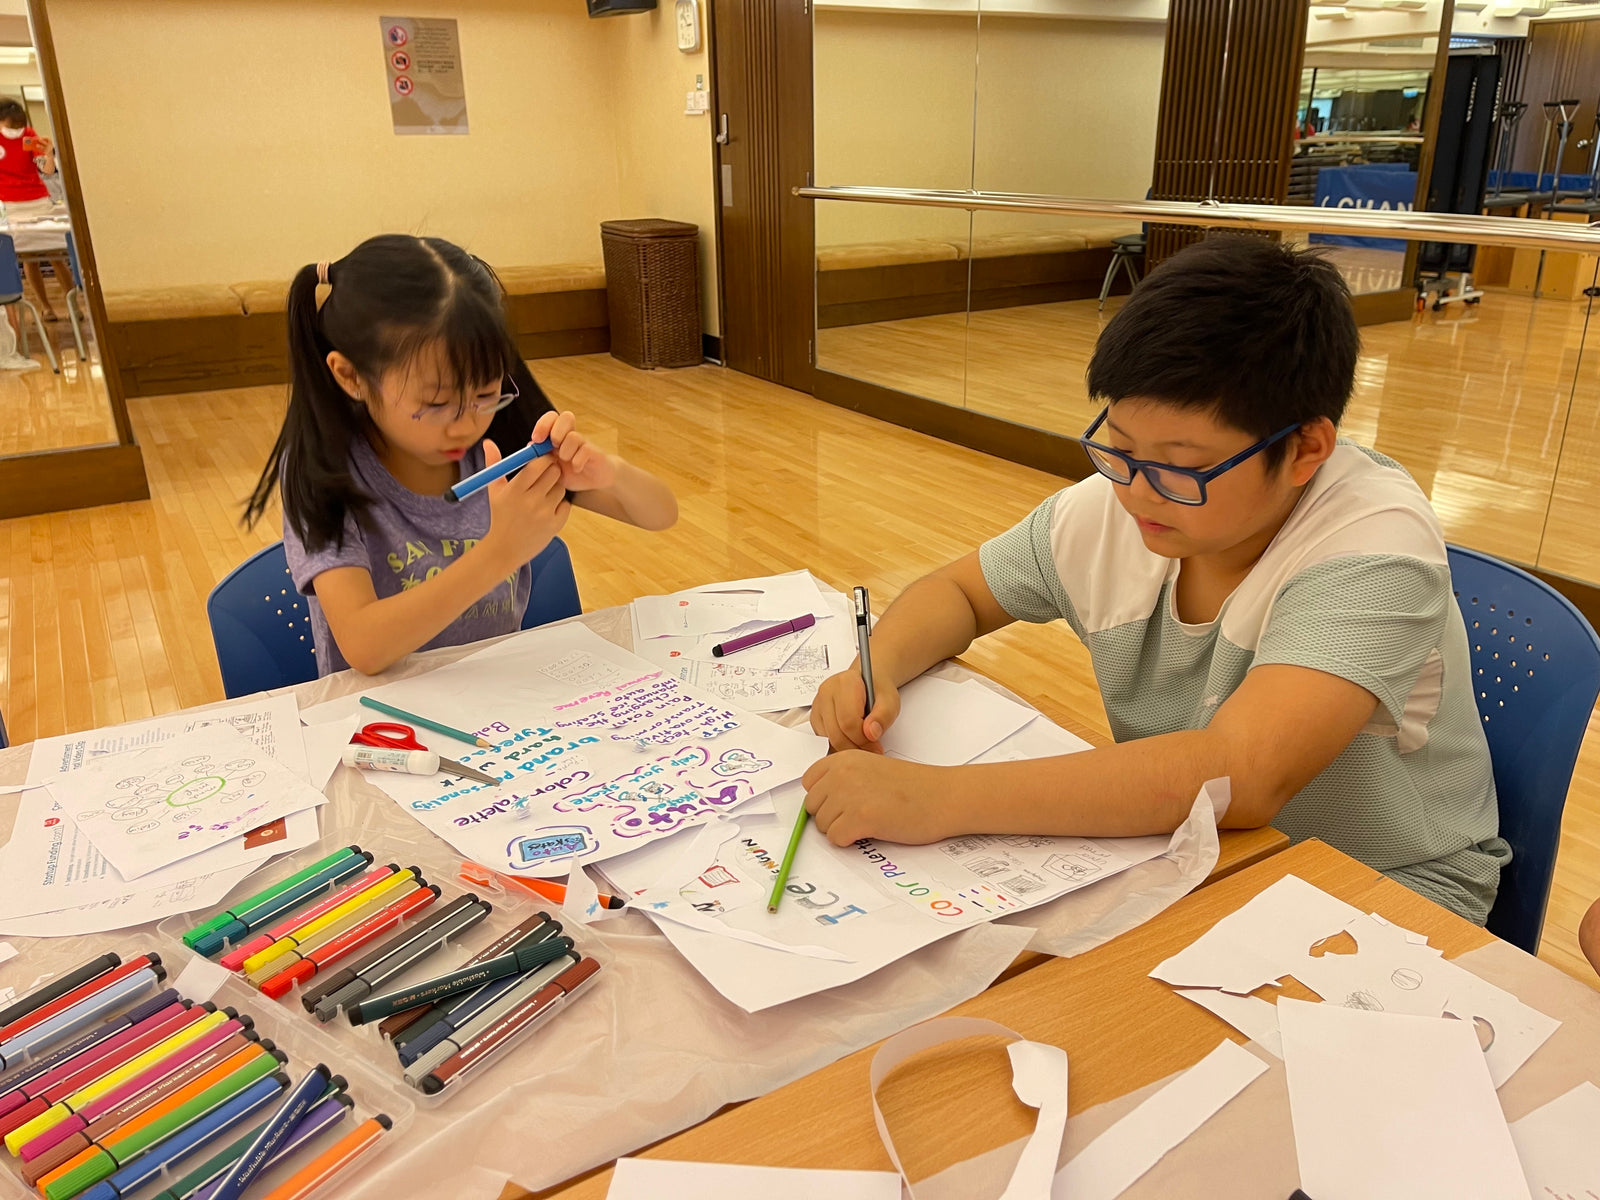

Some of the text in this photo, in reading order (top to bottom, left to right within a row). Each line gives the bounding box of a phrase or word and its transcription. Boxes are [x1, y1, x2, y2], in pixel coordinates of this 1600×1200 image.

[652, 677, 677, 689] into
[609, 701, 629, 713] ice
[656, 695, 693, 711] Pain
[587, 717, 609, 728] the
[456, 726, 554, 765] Typefac
[517, 735, 601, 773] brand
[440, 734, 562, 788] hard wrk
[530, 770, 591, 798] Color
[569, 753, 699, 806] help you skate
[741, 838, 779, 875] NGUIN
[420, 970, 487, 997] Washable Markers
